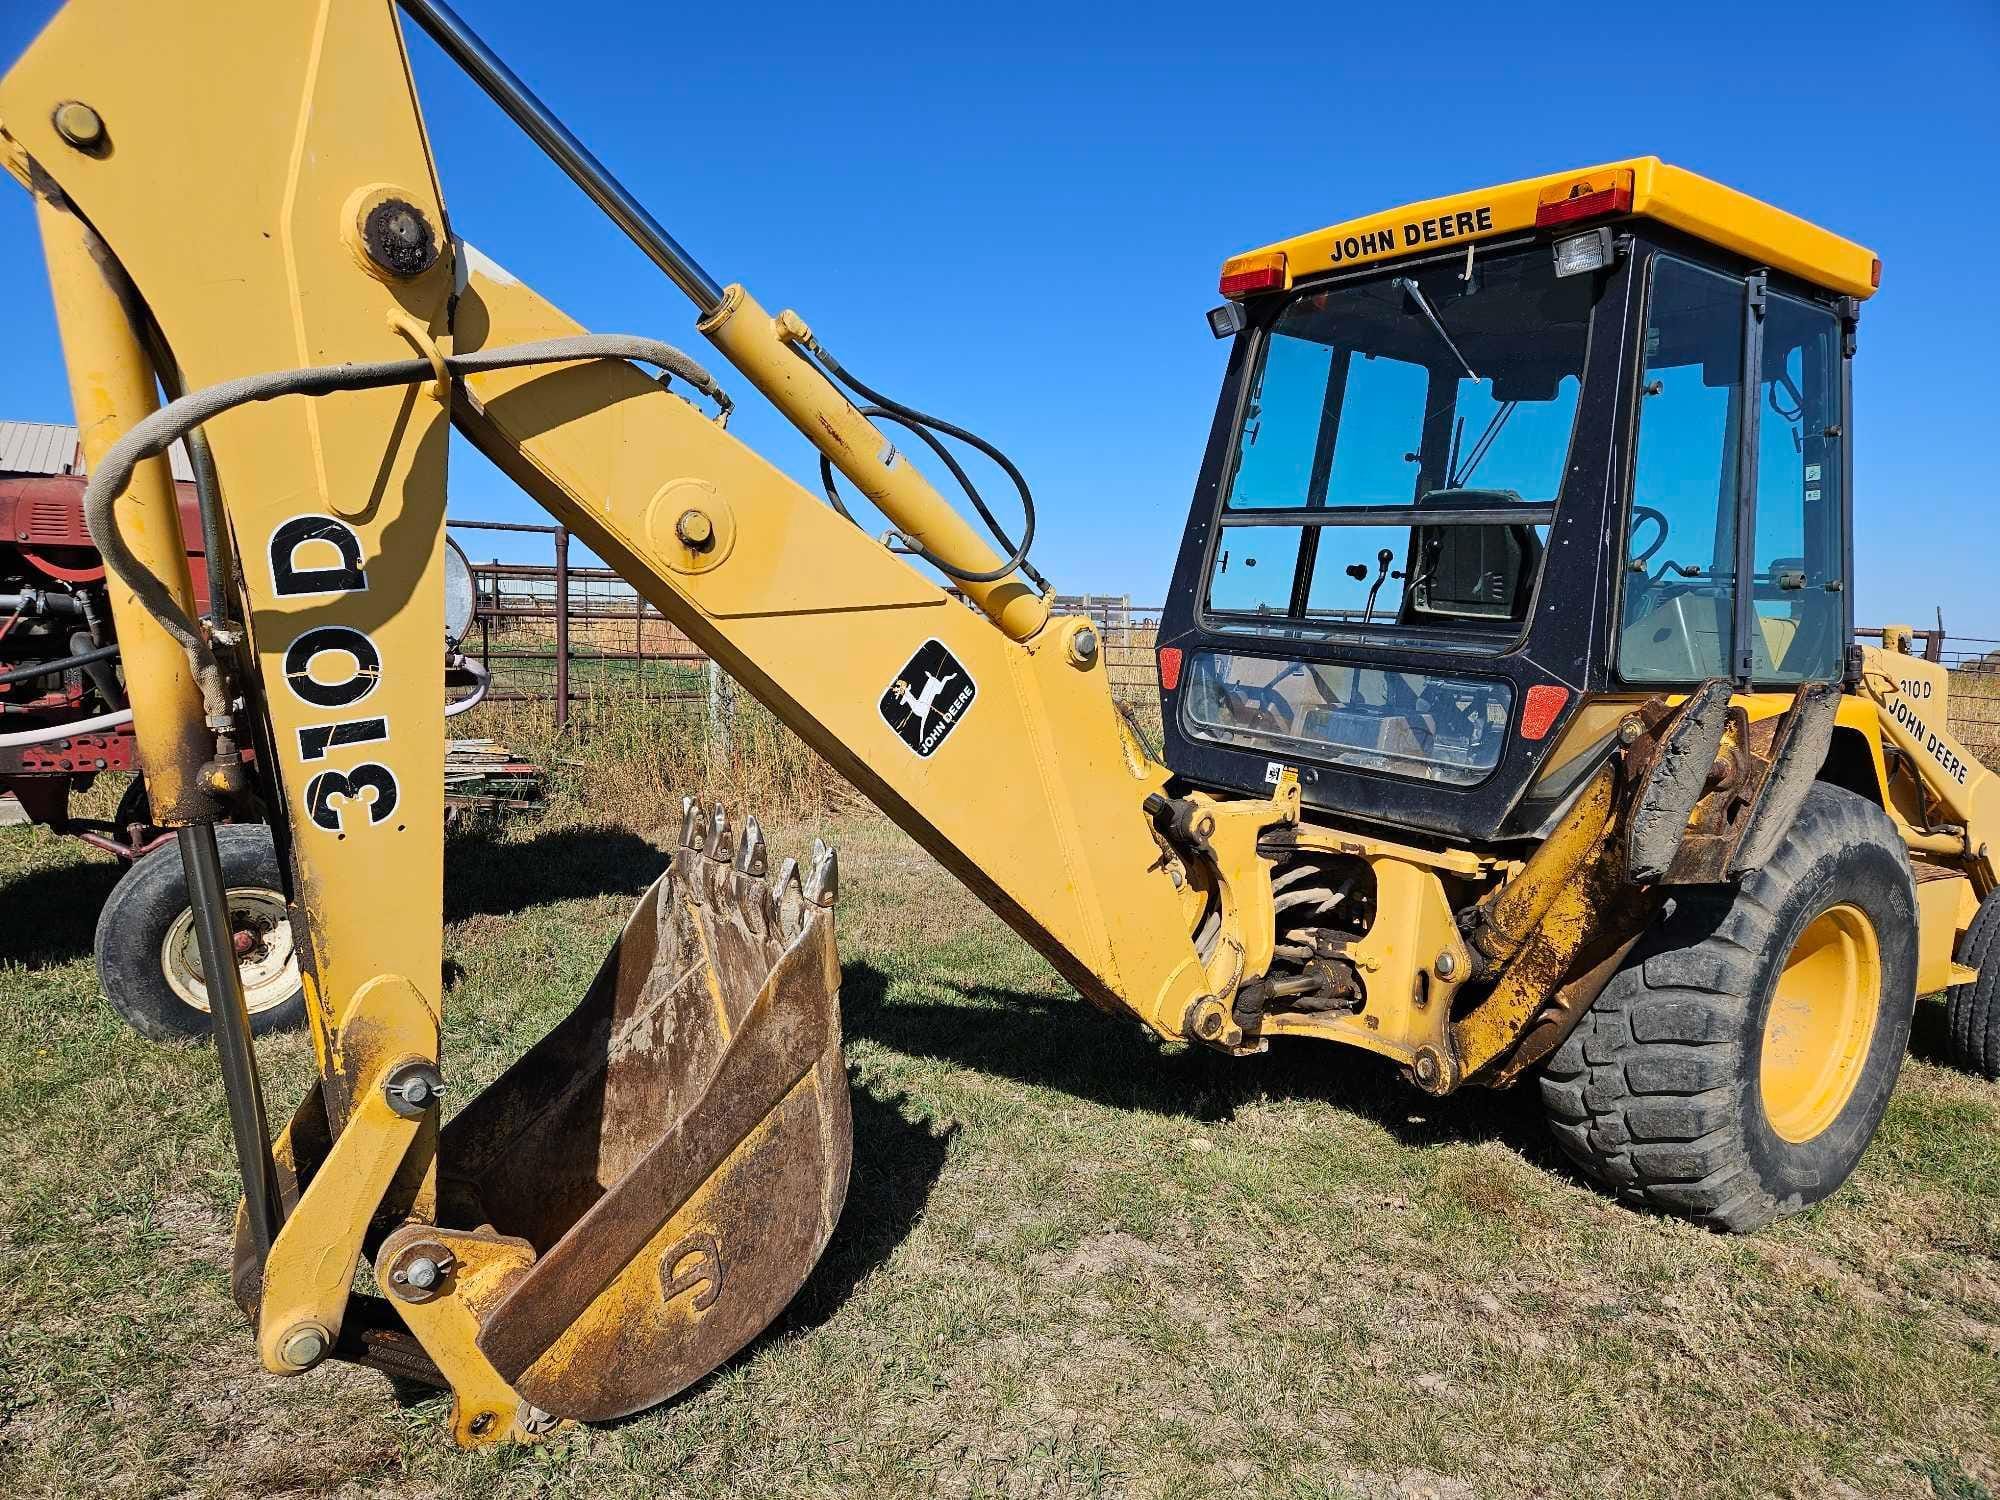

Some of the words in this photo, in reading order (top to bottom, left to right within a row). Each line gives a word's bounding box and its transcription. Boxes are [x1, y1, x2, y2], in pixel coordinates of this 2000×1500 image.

[1331, 229, 1395, 262] JOHN
[1404, 206, 1493, 246] DEERE
[268, 513, 369, 598] D
[282, 625, 400, 832] 310
[921, 723, 946, 754] JOHN
[942, 685, 973, 724] DEERE
[1923, 681, 1932, 699] D
[1888, 698, 1926, 742] JOHN
[1927, 732, 1969, 785] DEERE
